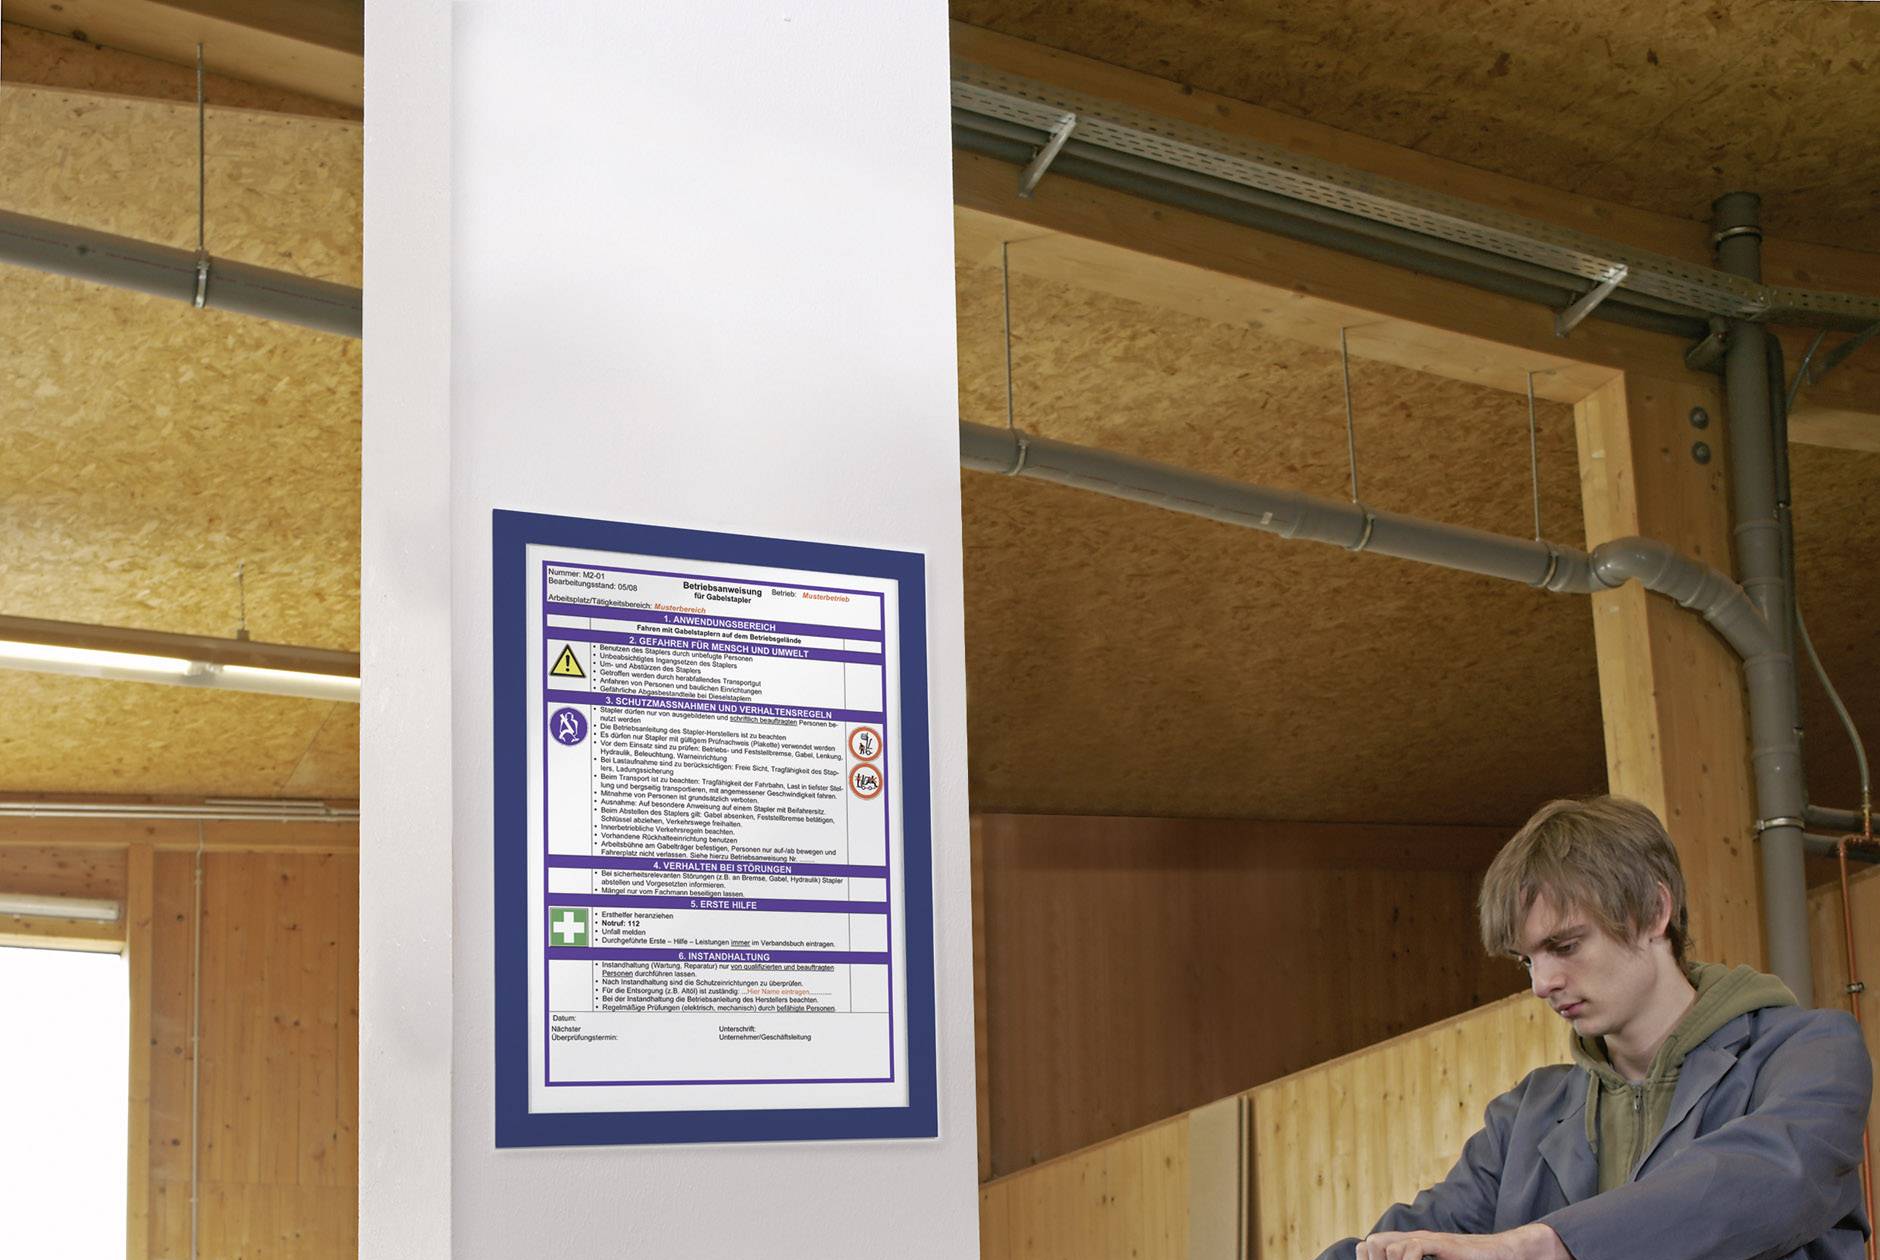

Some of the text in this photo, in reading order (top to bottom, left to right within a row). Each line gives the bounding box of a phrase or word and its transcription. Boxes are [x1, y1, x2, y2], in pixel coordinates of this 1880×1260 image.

[549, 567, 604, 579] Nummer: M2-01
[549, 576, 638, 592] Bearbeitungsstand: 05/08
[683, 581, 762, 597] Betriebsanweisung
[694, 591, 751, 604] für Gabelstapler
[772, 588, 850, 602] Betrieb: Musterbetrieb
[549, 593, 706, 613] Arbeitsplatz/Tätigkeitsbereich: Musterbereich
[665, 614, 776, 631] 1. ANWENDUNGSBEREICH
[637, 623, 661, 632] Fahren
[675, 627, 720, 637] Gabelstaplern
[750, 633, 801, 644] Betriebsgelände
[600, 642, 630, 652] Benutzen
[645, 647, 671, 656] Staplers
[672, 649, 690, 657] durch
[692, 652, 722, 660] unbefugte
[724, 653, 753, 662] Personen
[629, 635, 808, 658] 2. GEFAHREN FÜR MENSCH UND UMWELT
[600, 652, 654, 663] Unbeabsichtigtes
[656, 656, 698, 666] Ingangsetzen
[712, 660, 737, 669] Staplers
[629, 662, 661, 671] Abstürzen
[676, 665, 701, 674] Staplers
[600, 668, 761, 688] Getroffen werden durch herabfallendes Transportgut
[600, 677, 629, 685] Anfahren
[644, 680, 674, 688] Personen
[689, 683, 719, 692] baulichen
[720, 685, 762, 696] Einrichtungen
[600, 685, 636, 694] Gefährliche
[638, 688, 696, 699] Abgasbestandteile
[709, 692, 752, 703] Dieselstaplern
[606, 696, 832, 719] 3. SCHUTZMASSNAHMEN UND VERHALTENSREGELN
[600, 722, 611, 730] Die
[613, 723, 668, 735] Betriebsanleitung
[683, 727, 739, 738] Stapler-Herstellers
[758, 732, 787, 741] beachten
[601, 747, 727, 763] Hydraulik, Beleuchtung, Warneinrichtung
[616, 765, 674, 776] Ladungssicherung
[601, 789, 632, 798] Mitnahme
[648, 791, 678, 800] Personen
[688, 794, 729, 802] grundsätzlich
[601, 814, 632, 823] Schlüssel
[666, 817, 711, 827] Verkehrswege
[601, 823, 735, 835] Innerbetriebliche Verkehrsregeln beachten.
[601, 831, 738, 844] Vorhandene Rückhalteeinrichtung benutzen
[653, 861, 791, 874] 4. VERHALTEN BEI STÖRUNGEN
[602, 878, 630, 886] abstellen
[646, 879, 688, 888] Vorgesetzten
[689, 880, 726, 889] informieren.
[602, 886, 625, 896] Mängel
[690, 889, 722, 898] beseitigen
[691, 899, 757, 909] 5. ERSTE HILFE
[602, 910, 632, 918] Ersthelfer
[628, 919, 640, 927] 112
[622, 928, 646, 936] melden
[679, 951, 770, 961] 6. INSTANDHALTUNG
[602, 969, 633, 978] Personen
[621, 978, 668, 987] Instandhaltung
[670, 978, 683, 986] sind
[696, 979, 758, 987] Schutzeinrichtungen
[769, 979, 803, 987] überprüfen.
[553, 1014, 576, 1022] Datum:
[552, 1033, 617, 1042] Überprüfungstermin:
[719, 1033, 812, 1041] Unternehmer/Geschäftsleitung
